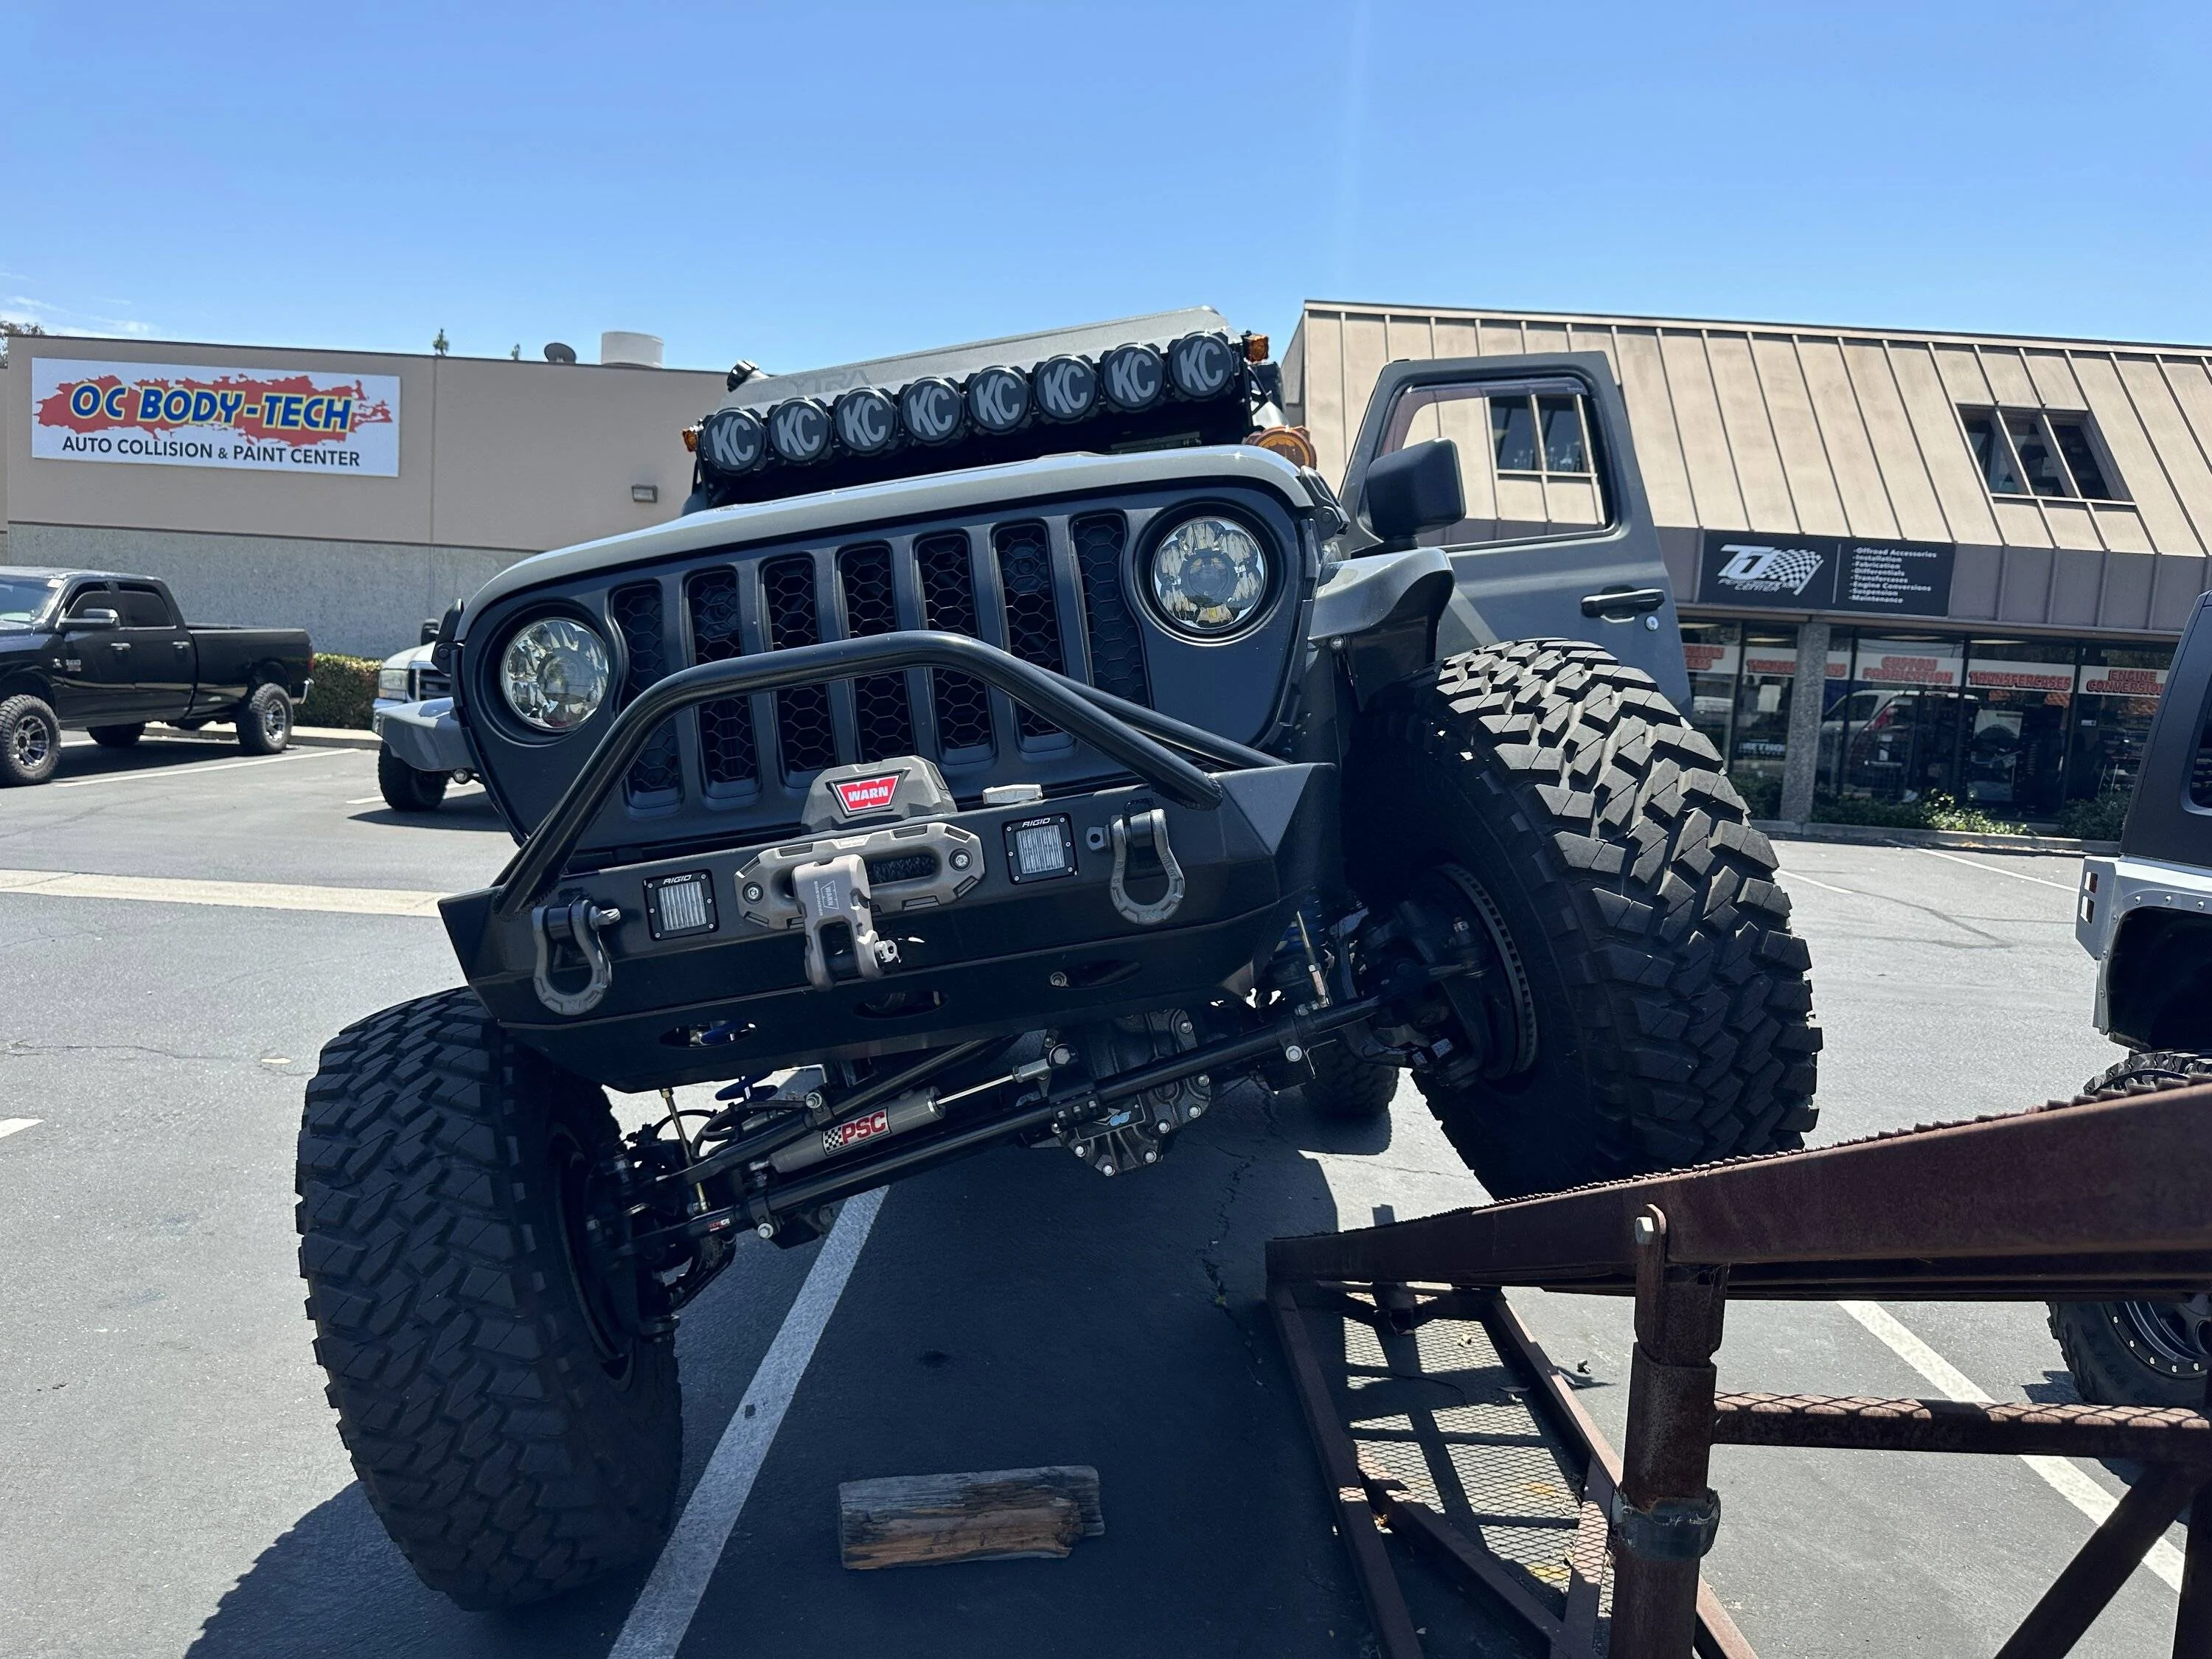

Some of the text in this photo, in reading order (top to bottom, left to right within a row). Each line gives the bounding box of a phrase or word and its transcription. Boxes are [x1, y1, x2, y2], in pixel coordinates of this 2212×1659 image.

[1043, 363, 1088, 413] KC
[1111, 352, 1155, 402] KC
[1180, 341, 1223, 391] KC
[69, 382, 355, 433] OC BODY-TECH
[843, 397, 886, 446] KC
[909, 386, 953, 436] KC
[975, 375, 1020, 425] KC
[63, 436, 361, 467] AUTO COLLISION & PAINT CENTER
[712, 417, 754, 465] KC
[776, 406, 820, 456] KC
[2109, 669, 2157, 683] ENGINE
[848, 786, 889, 802] WARN
[1022, 817, 1051, 828] RIGID
[663, 874, 692, 885] RIGID
[841, 1112, 886, 1144] PSC
